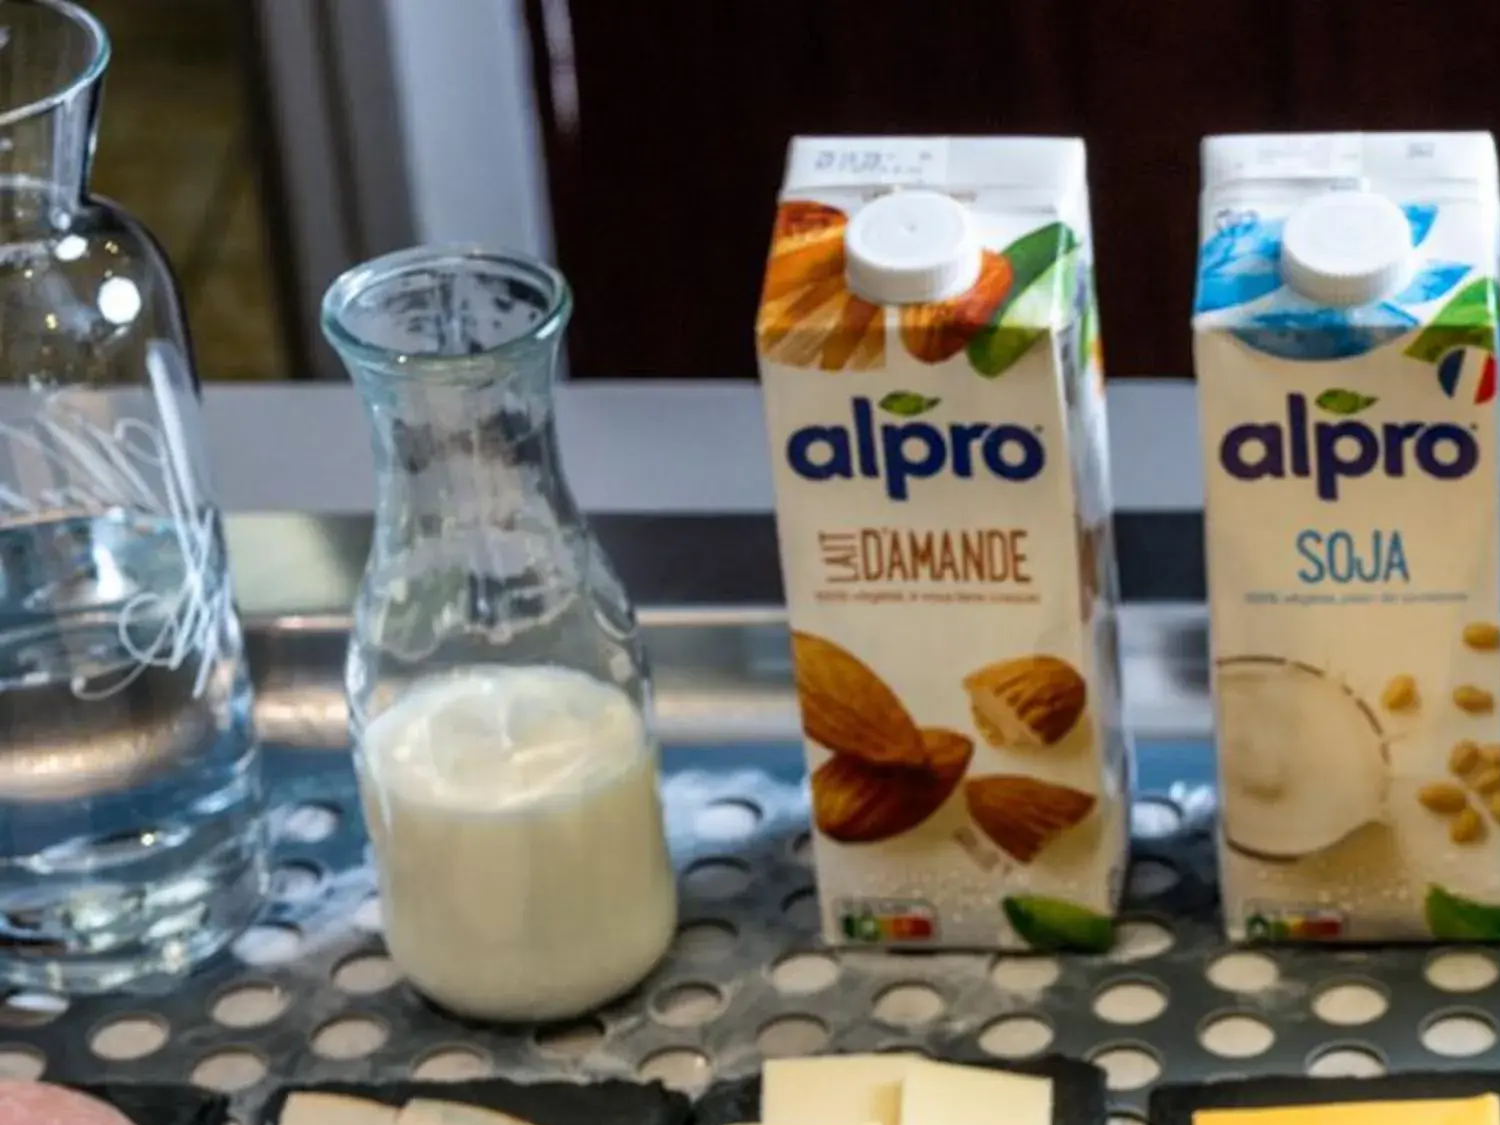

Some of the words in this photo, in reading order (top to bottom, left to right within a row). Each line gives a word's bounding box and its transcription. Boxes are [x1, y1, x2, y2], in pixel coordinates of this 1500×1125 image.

[785, 397, 1046, 502] alpro
[1219, 392, 1481, 502] alpro
[818, 531, 860, 583] LAIT
[1295, 529, 1411, 585] SOJA
